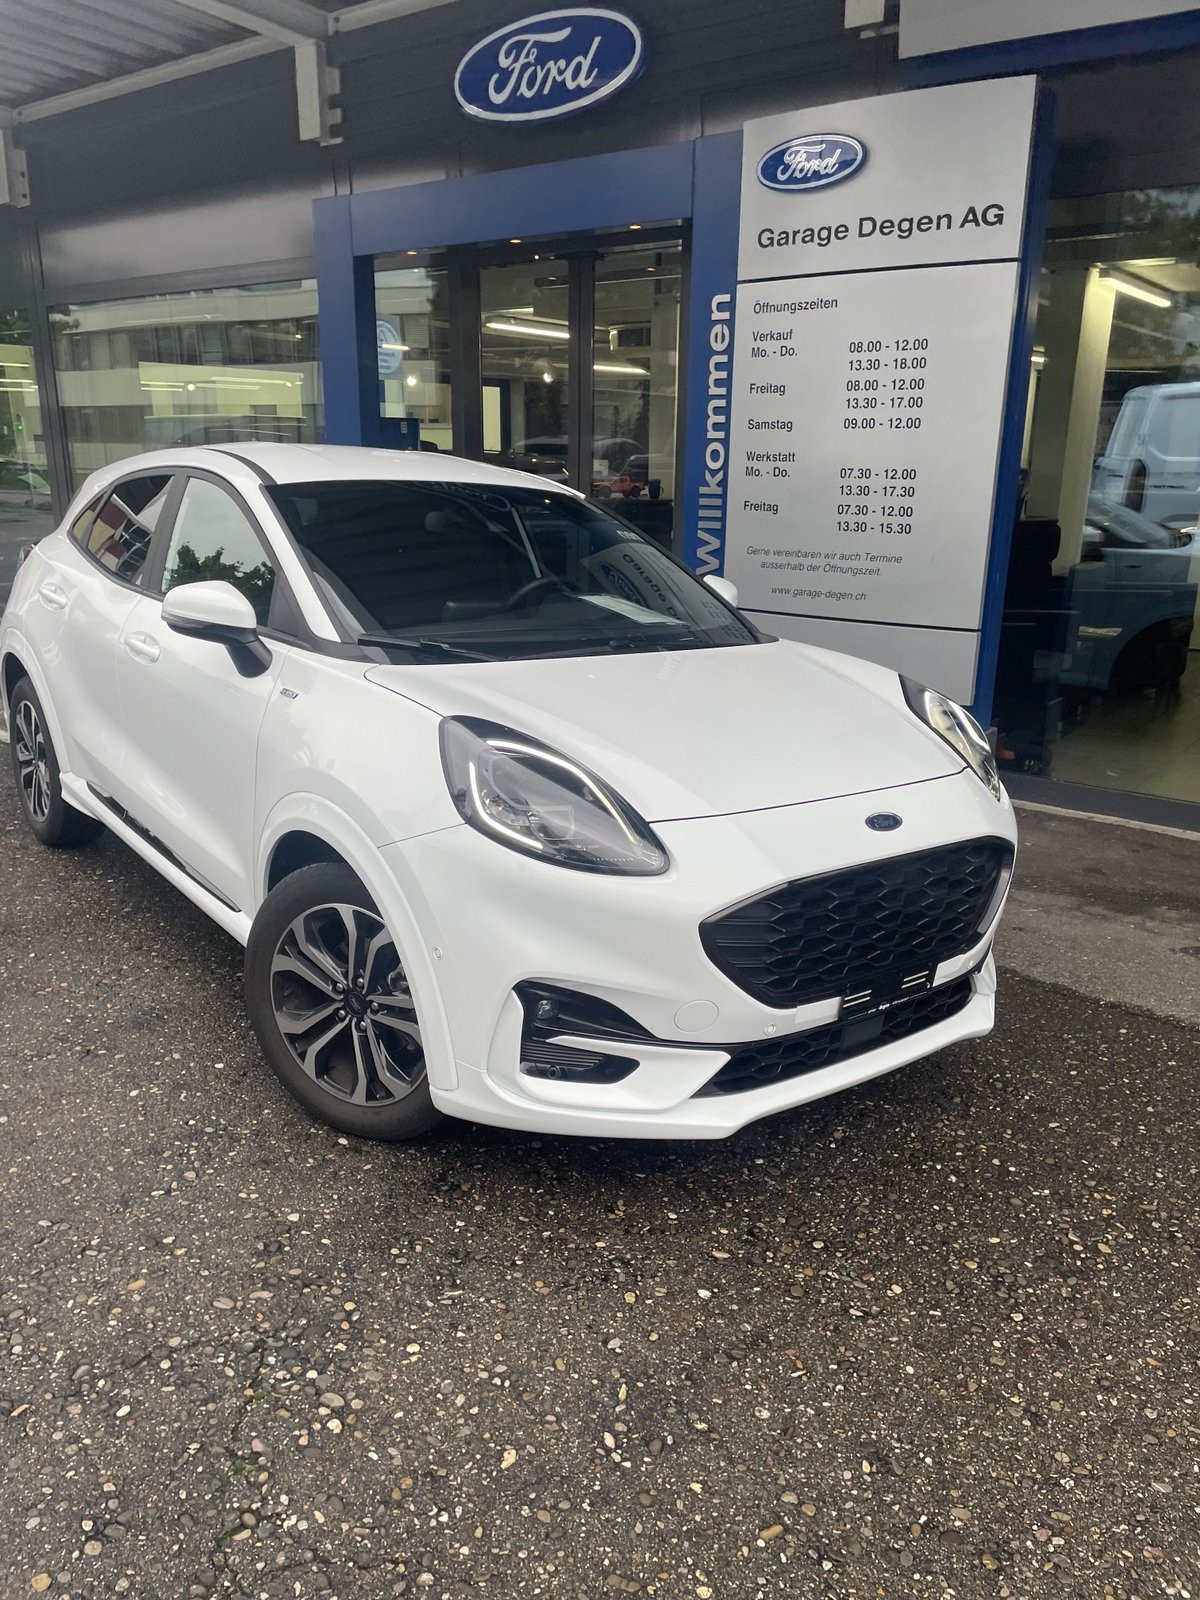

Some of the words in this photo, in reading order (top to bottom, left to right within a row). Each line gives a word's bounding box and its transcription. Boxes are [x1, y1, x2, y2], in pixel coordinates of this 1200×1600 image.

[488, 26, 601, 105] Ford
[776, 143, 842, 181] Ford
[757, 223, 850, 249] Garage
[857, 213, 953, 240] Degen
[958, 203, 1005, 229] AG
[753, 297, 838, 315] Öffnungszeiten
[752, 328, 793, 342] Verkauf
[751, 346, 770, 358] Mo.
[780, 345, 798, 357] Do.
[849, 340, 882, 354] 08.00
[894, 338, 929, 352] 12.00
[848, 358, 881, 372] 13.30
[893, 356, 927, 370] 18.00
[749, 383, 786, 397] Freitag
[846, 379, 879, 392] 08.00
[891, 378, 925, 391] 12.00
[846, 397, 878, 410] 13.30
[890, 396, 924, 409] 17.00
[747, 418, 793, 433] Samstag
[843, 417, 876, 430] 09.00
[888, 417, 922, 430] 12.00
[695, 293, 731, 575] Willkommen
[746, 450, 796, 463] Werkstatt
[745, 465, 763, 478] Mo.
[772, 466, 791, 478] Do.
[839, 467, 872, 480] 07.30
[883, 468, 917, 481] 12.00
[839, 484, 871, 497] 13.30
[882, 485, 915, 498] 17.30
[743, 500, 779, 515] Freitag
[837, 504, 869, 516] 07.30
[881, 505, 914, 518] 12.00
[836, 520, 868, 533] 13.30
[879, 522, 912, 535] 15.30
[746, 545, 771, 557] Gerne
[772, 549, 822, 560] vereinbaren
[823, 550, 838, 561] wir
[838, 551, 862, 562] auch
[864, 552, 903, 564] Termine
[760, 560, 805, 572] ausserhalb
[806, 562, 822, 574] der
[771, 586, 867, 602] www.garage-degen.ch
